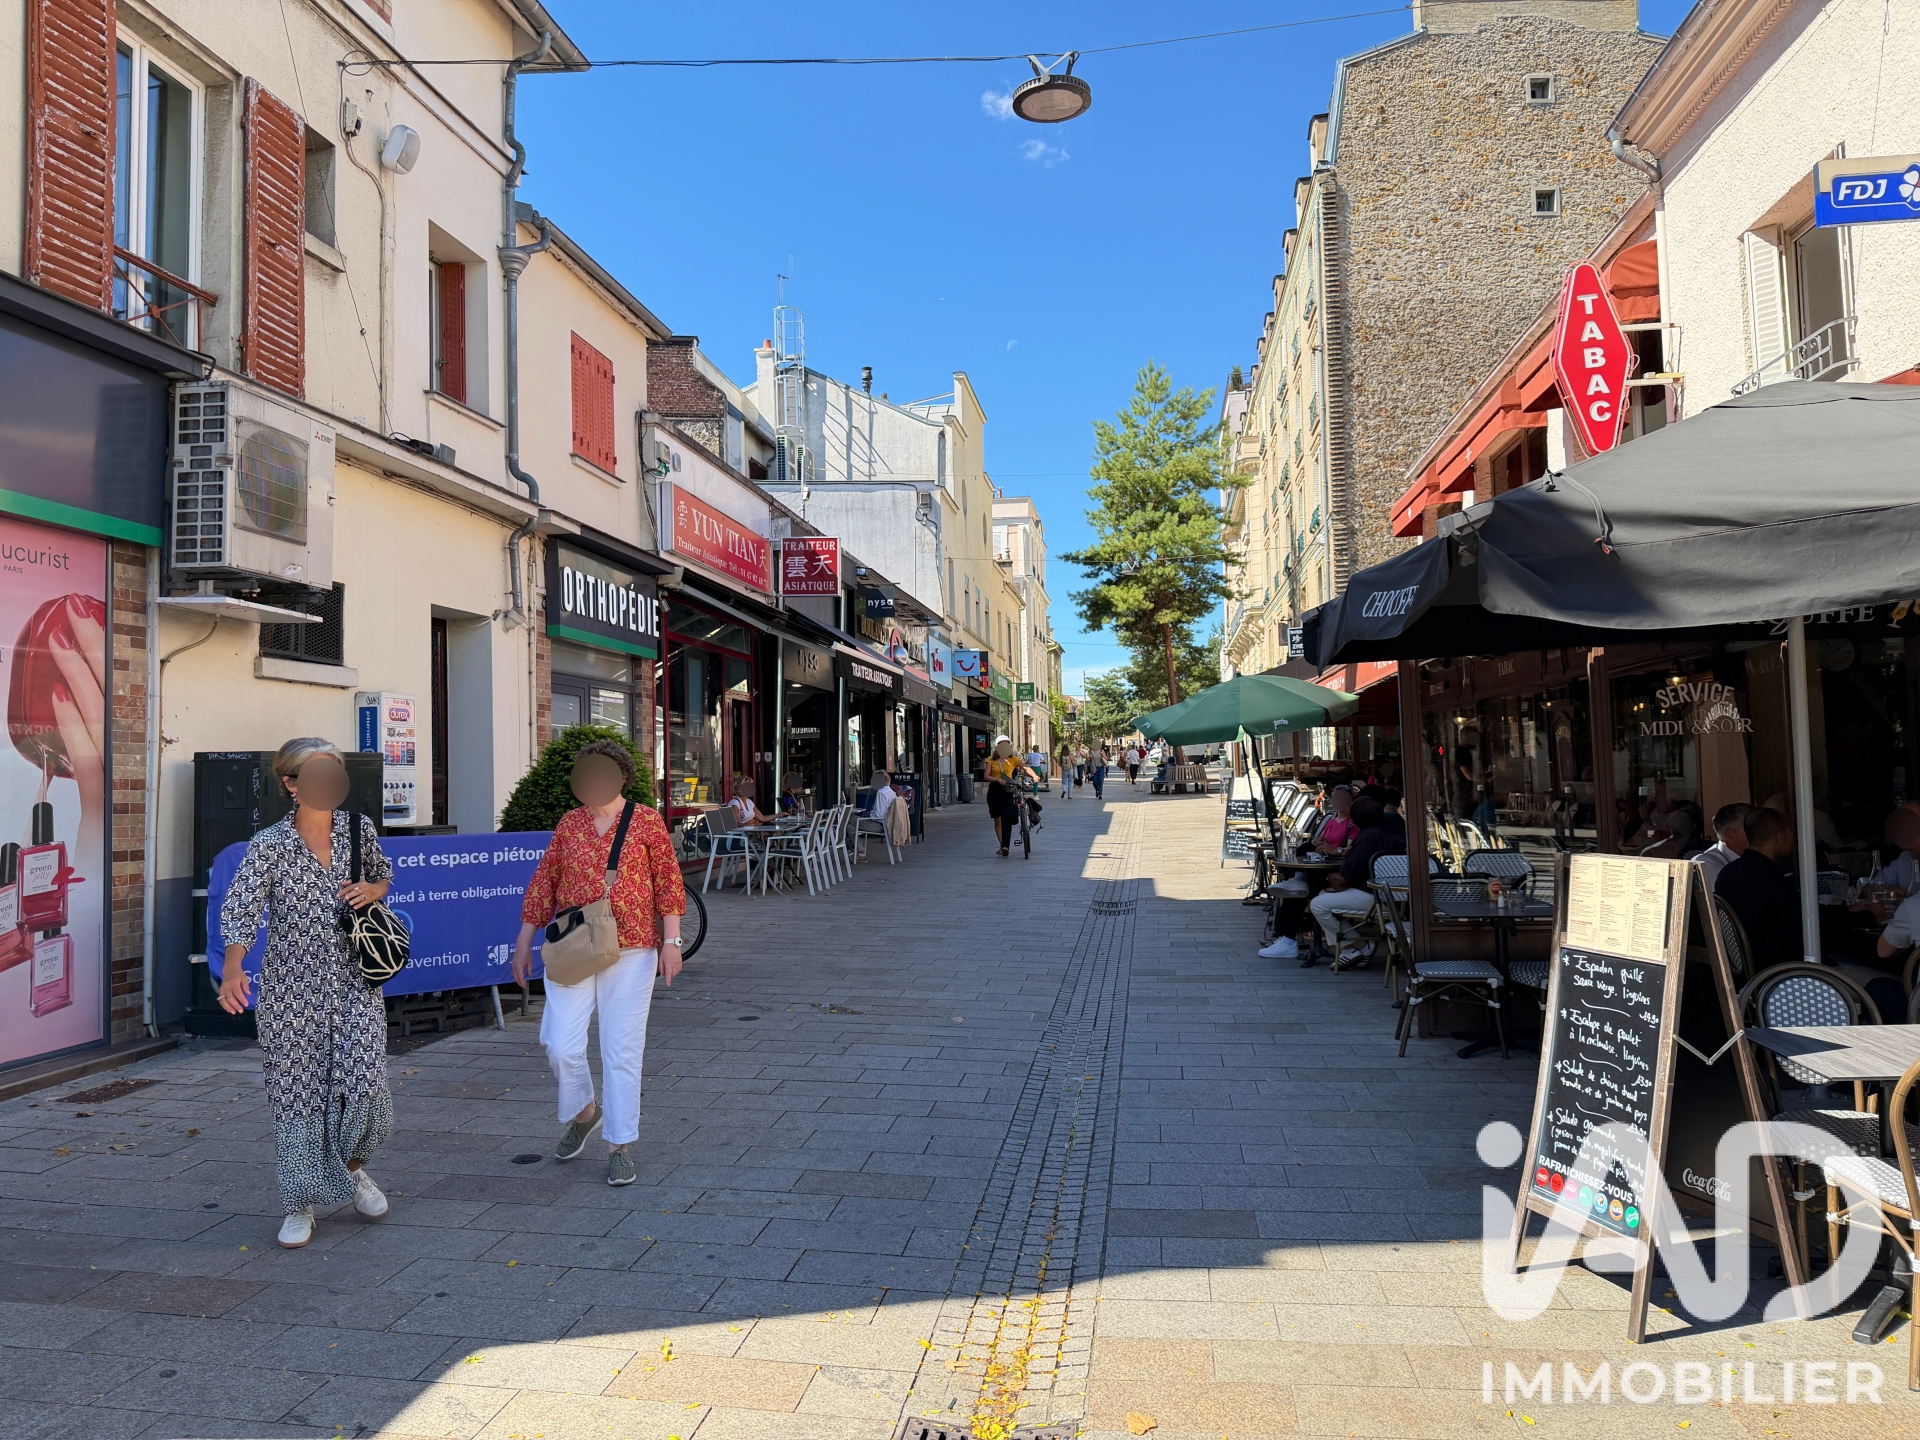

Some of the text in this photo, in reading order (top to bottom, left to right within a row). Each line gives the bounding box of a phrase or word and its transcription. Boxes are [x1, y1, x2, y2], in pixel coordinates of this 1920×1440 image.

[1838, 179, 1887, 200] FDJ
[1577, 294, 1612, 421] TABAC
[691, 508, 757, 565] YUN TIAN
[784, 541, 836, 551] TRAITEUR
[677, 536, 702, 555] Traiteur
[702, 549, 727, 568] Asiatique
[3, 565, 24, 574] PARIS
[786, 555, 833, 577] 雲天
[784, 582, 835, 591] ASIATIQUE
[563, 566, 659, 638] ORTHOPÉDIE
[867, 599, 894, 608] nysa
[851, 662, 873, 682] TRAITEUR
[1498, 659, 1515, 676] TABAC
[1656, 682, 1735, 709] SERVICE
[391, 708, 408, 719] durex
[1639, 718, 1755, 736] MIDI & SOIR
[29, 864, 52, 875] green
[397, 852, 426, 868] cet
[429, 852, 489, 867] espace
[32, 870, 50, 883] jelly
[386, 884, 524, 909] pied à terre obligatoire
[40, 955, 59, 967] green
[42, 962, 57, 974] jelly
[405, 951, 470, 969] avention
[1573, 955, 1645, 985] Espadon grillé
[1622, 986, 1650, 1006] linguines
[1569, 1009, 1642, 1047] Escalope de poulet
[1569, 1027, 1575, 1040] à
[1578, 1027, 1586, 1042] la
[1623, 1045, 1649, 1071] linguines
[1562, 1059, 1585, 1076] Salade
[1587, 1069, 1596, 1082] de
[1584, 1086, 1593, 1096] et
[1594, 1089, 1602, 1099] de
[1625, 1103, 1632, 1113] de
[1555, 1107, 1579, 1127] Salade
[1539, 1154, 1633, 1204] RAFRAICHISSEZ-VOUS
[1682, 1167, 1733, 1203] Coca-Cola
